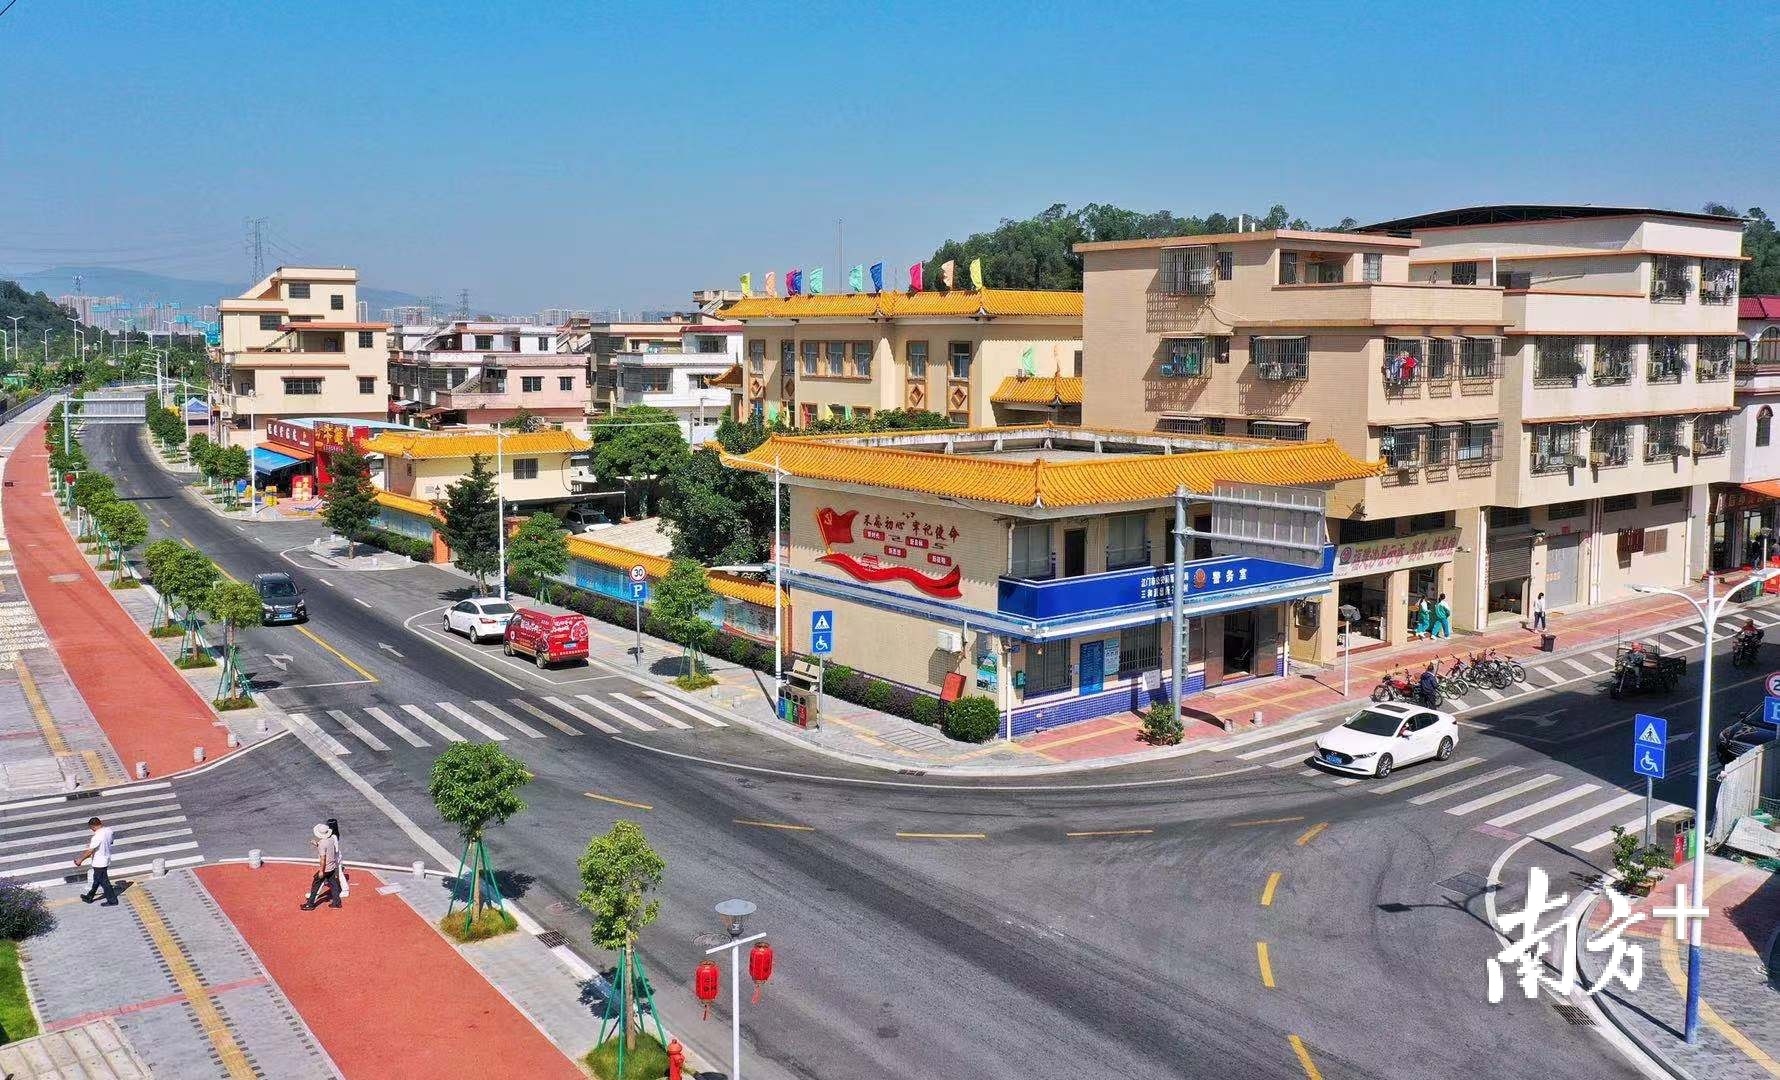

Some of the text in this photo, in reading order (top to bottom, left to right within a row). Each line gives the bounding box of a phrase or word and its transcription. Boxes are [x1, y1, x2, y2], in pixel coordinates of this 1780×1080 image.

[912, 520, 960, 543] 牢记使命
[634, 568, 644, 577] 30
[1212, 568, 1247, 584] 警务室
[633, 584, 643, 598] P
